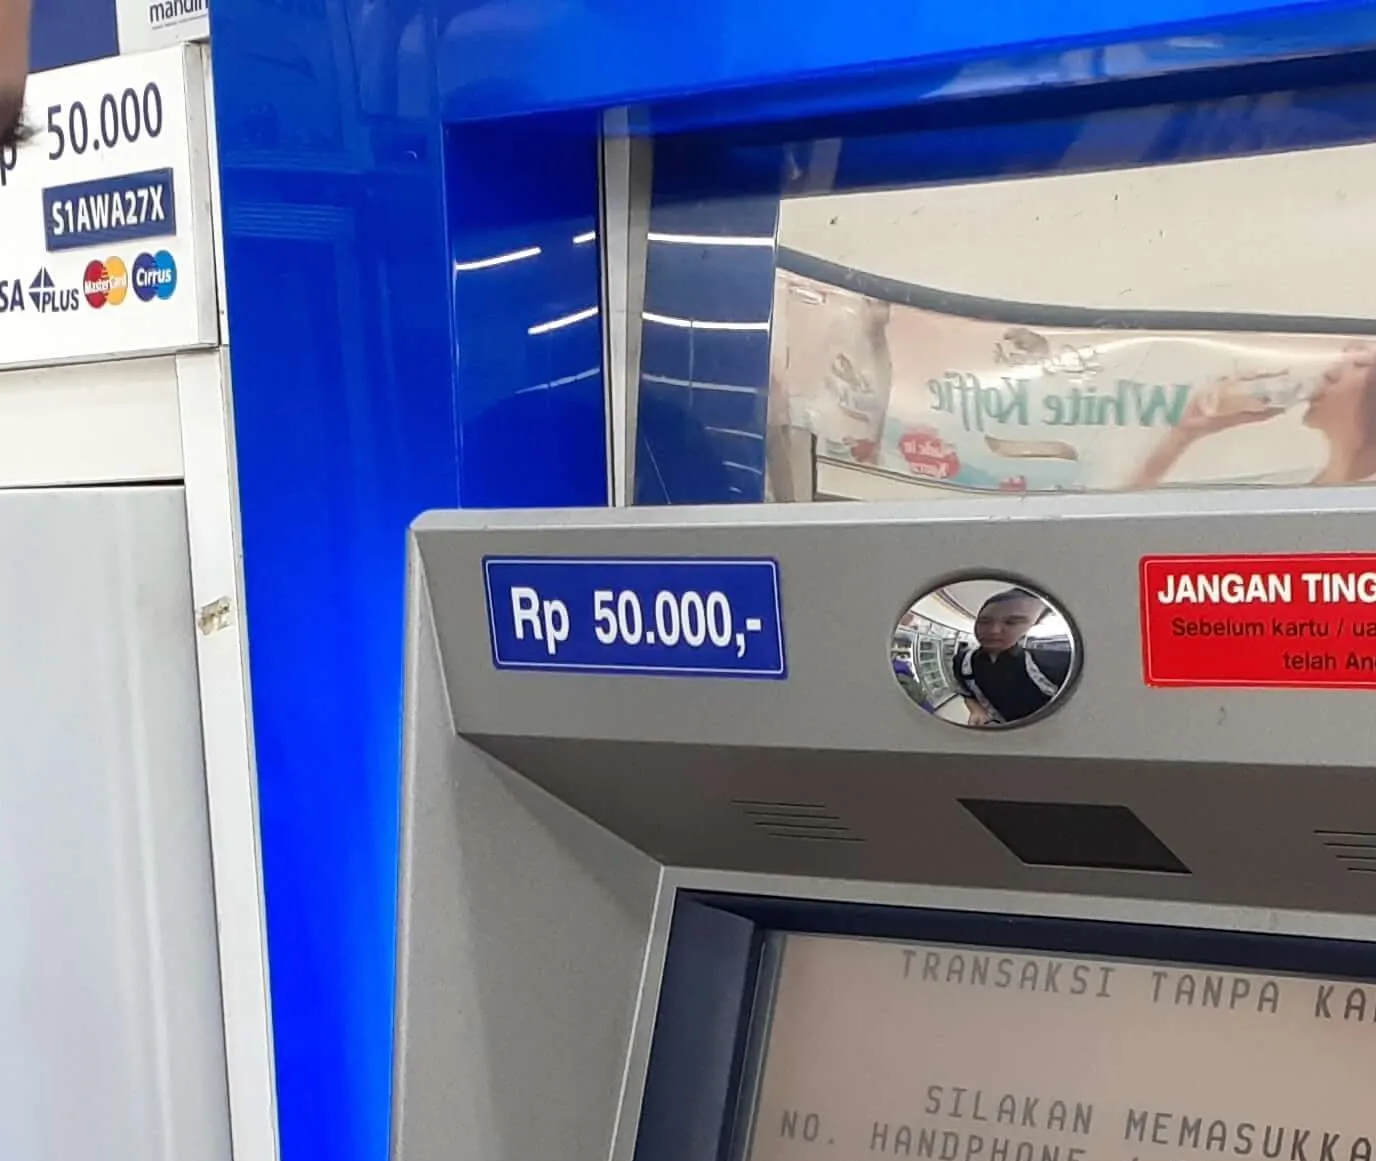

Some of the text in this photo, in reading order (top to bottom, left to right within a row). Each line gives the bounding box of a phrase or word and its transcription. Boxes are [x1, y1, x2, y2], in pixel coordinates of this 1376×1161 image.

[47, 82, 163, 160] 50.000
[51, 184, 165, 236] S1AWA27X
[84, 275, 127, 296] MasterCard
[135, 267, 172, 287] Cirrus
[42, 289, 80, 314] PLUS
[1157, 573, 1292, 605] JANGAN
[511, 586, 762, 658] Rp 50.000,-
[1172, 616, 1265, 638] Sebelum
[1272, 617, 1330, 637] kartu
[1283, 651, 1337, 671] telah
[902, 949, 1116, 998] TRANSAKSI
[1150, 970, 1280, 1015] TANPA
[925, 1084, 1094, 1135] SILAKAN
[780, 1110, 836, 1145] NO.
